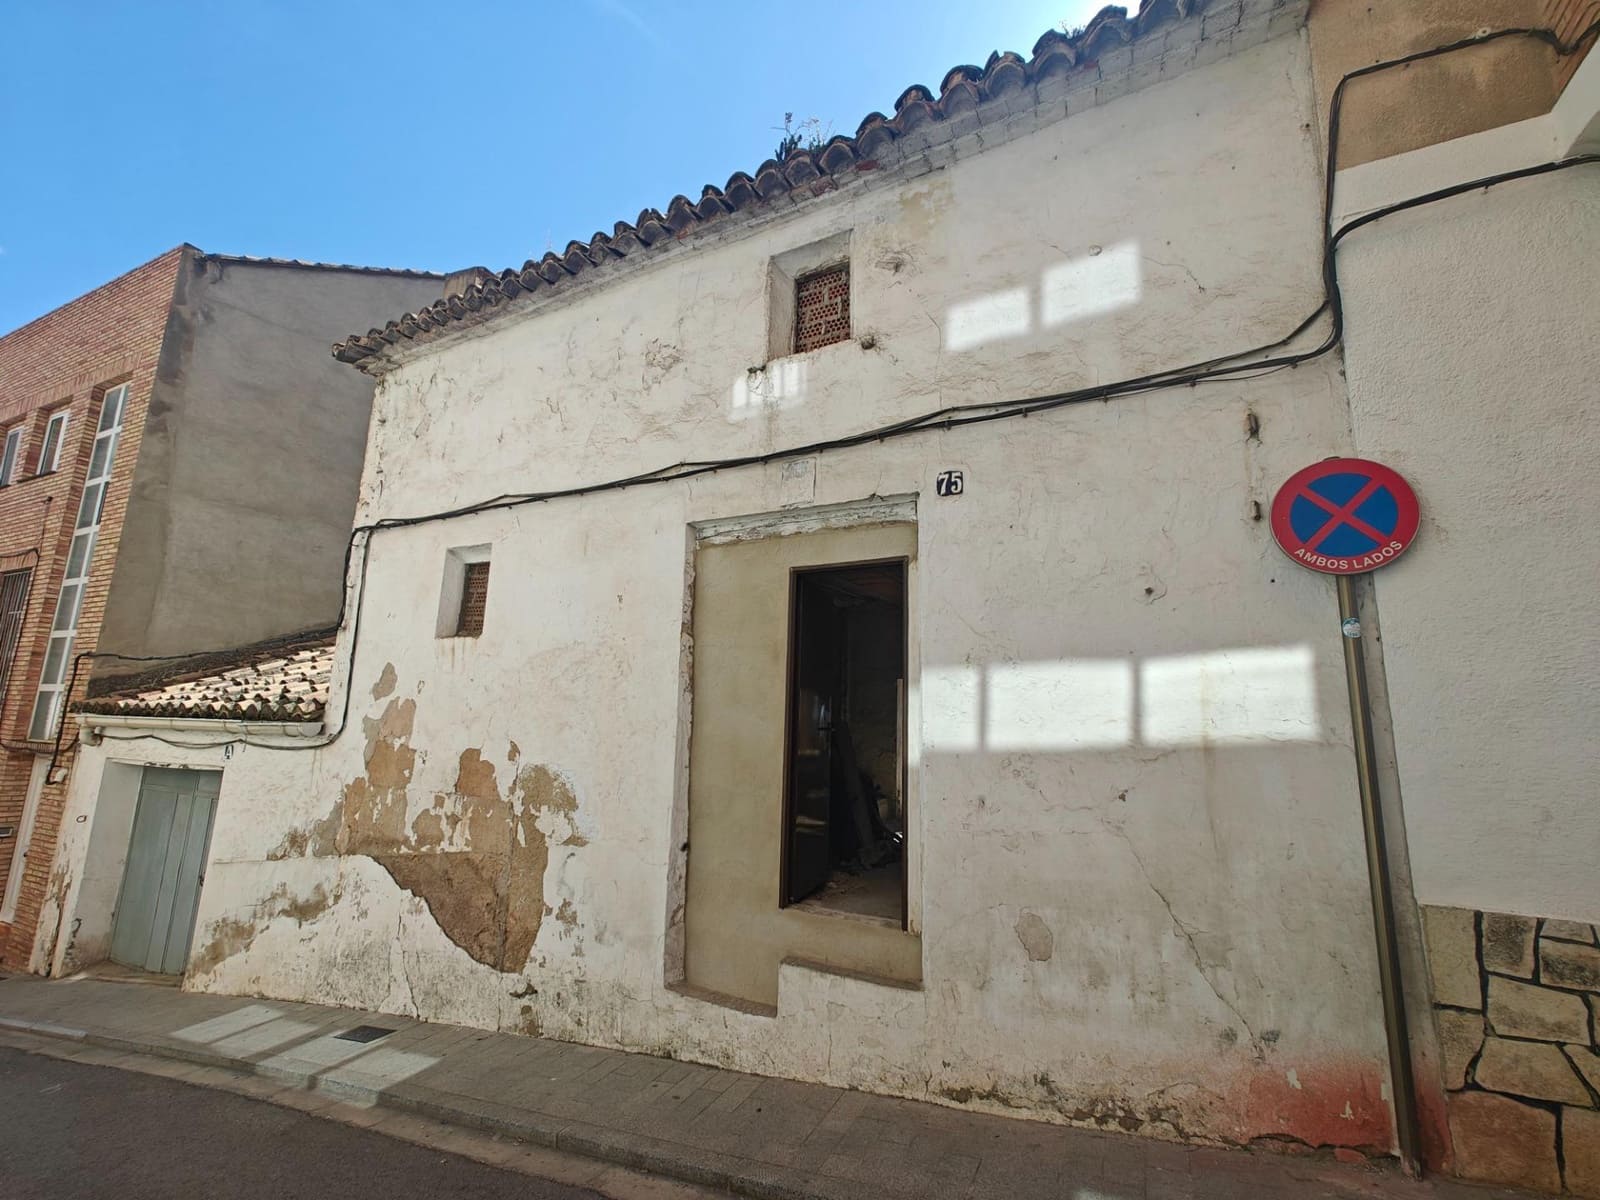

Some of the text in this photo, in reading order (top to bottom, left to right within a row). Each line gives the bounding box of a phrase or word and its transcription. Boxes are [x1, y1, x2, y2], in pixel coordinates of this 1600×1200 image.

[938, 471, 962, 496] 75
[1294, 540, 1402, 570] AMBOS LADOS
